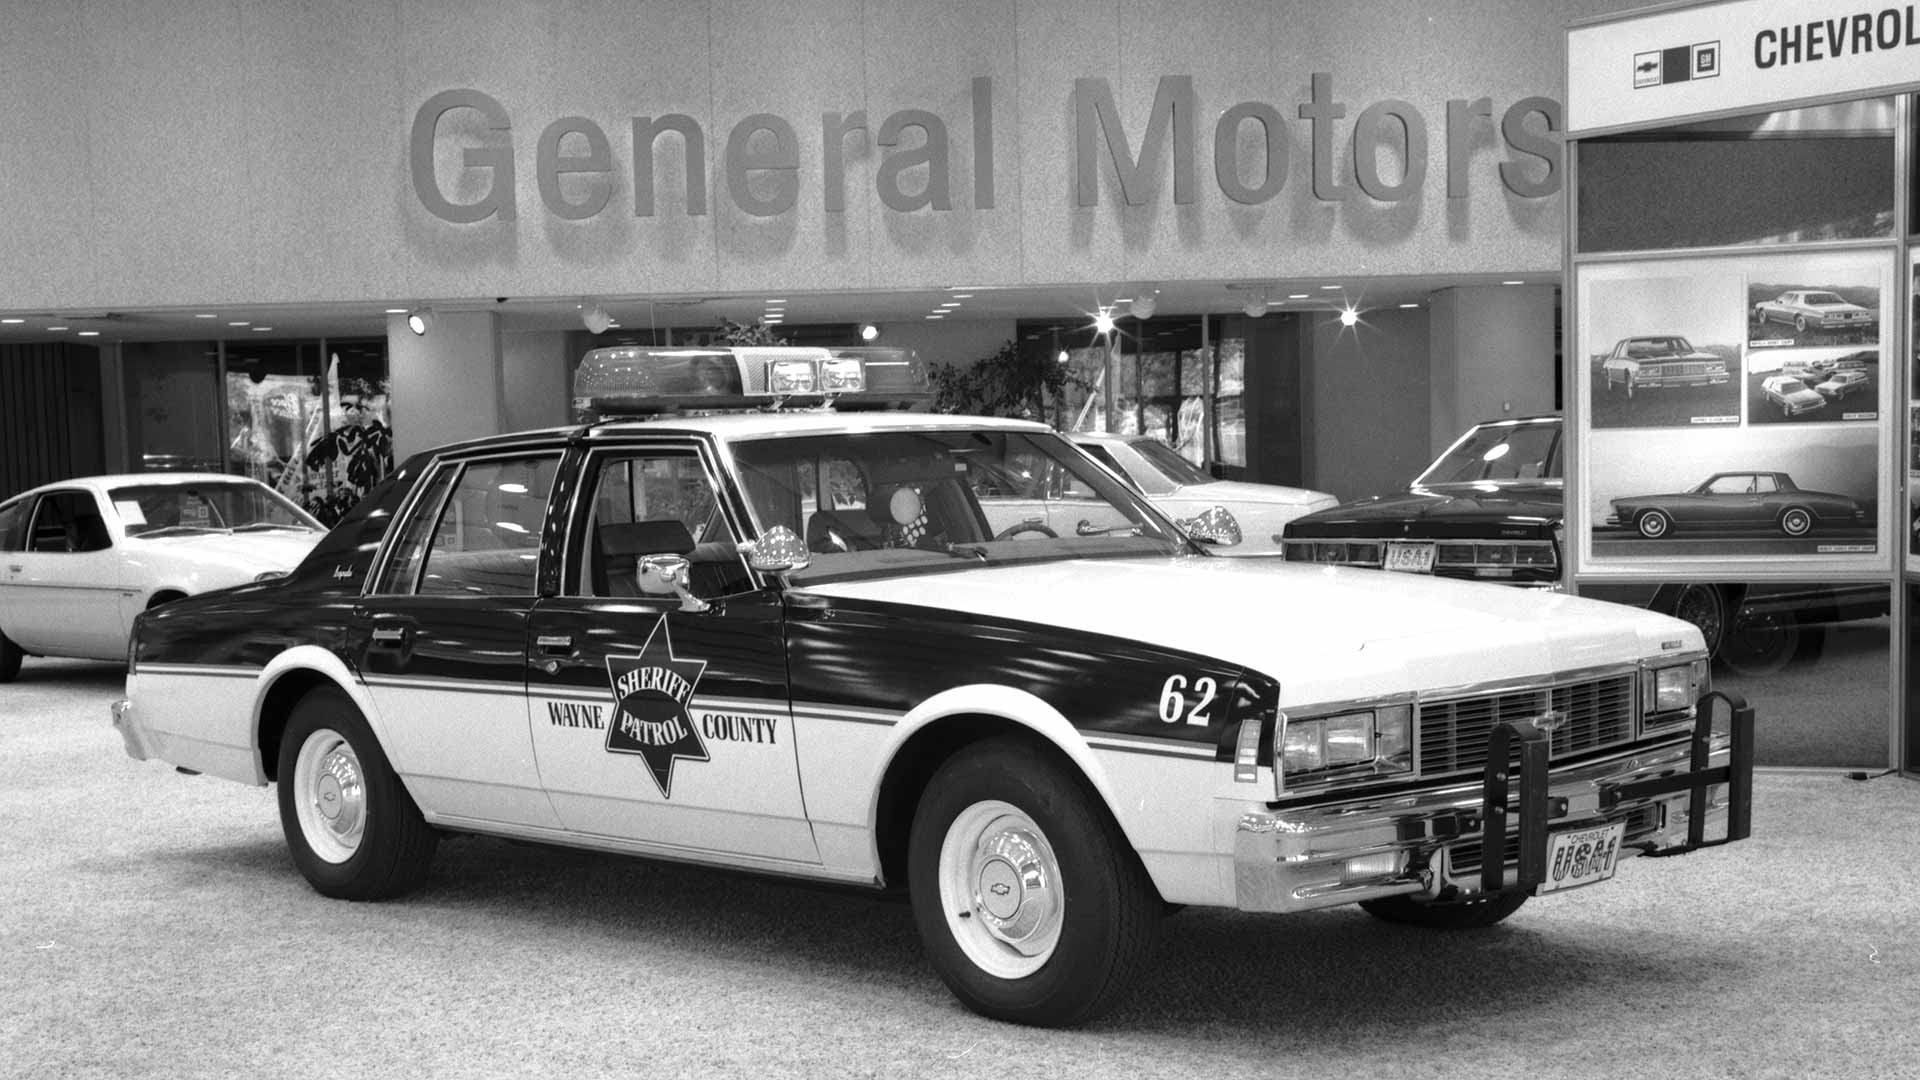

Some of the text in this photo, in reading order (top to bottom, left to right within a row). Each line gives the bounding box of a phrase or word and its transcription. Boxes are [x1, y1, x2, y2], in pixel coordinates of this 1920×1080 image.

[1754, 5, 1920, 69] CHEVROL
[410, 72, 1562, 223] General Motors
[618, 667, 691, 703] SHERIFF
[1159, 674, 1217, 727] 62
[548, 702, 777, 744] WAYNE COUNTY
[620, 710, 688, 746] PATROL
